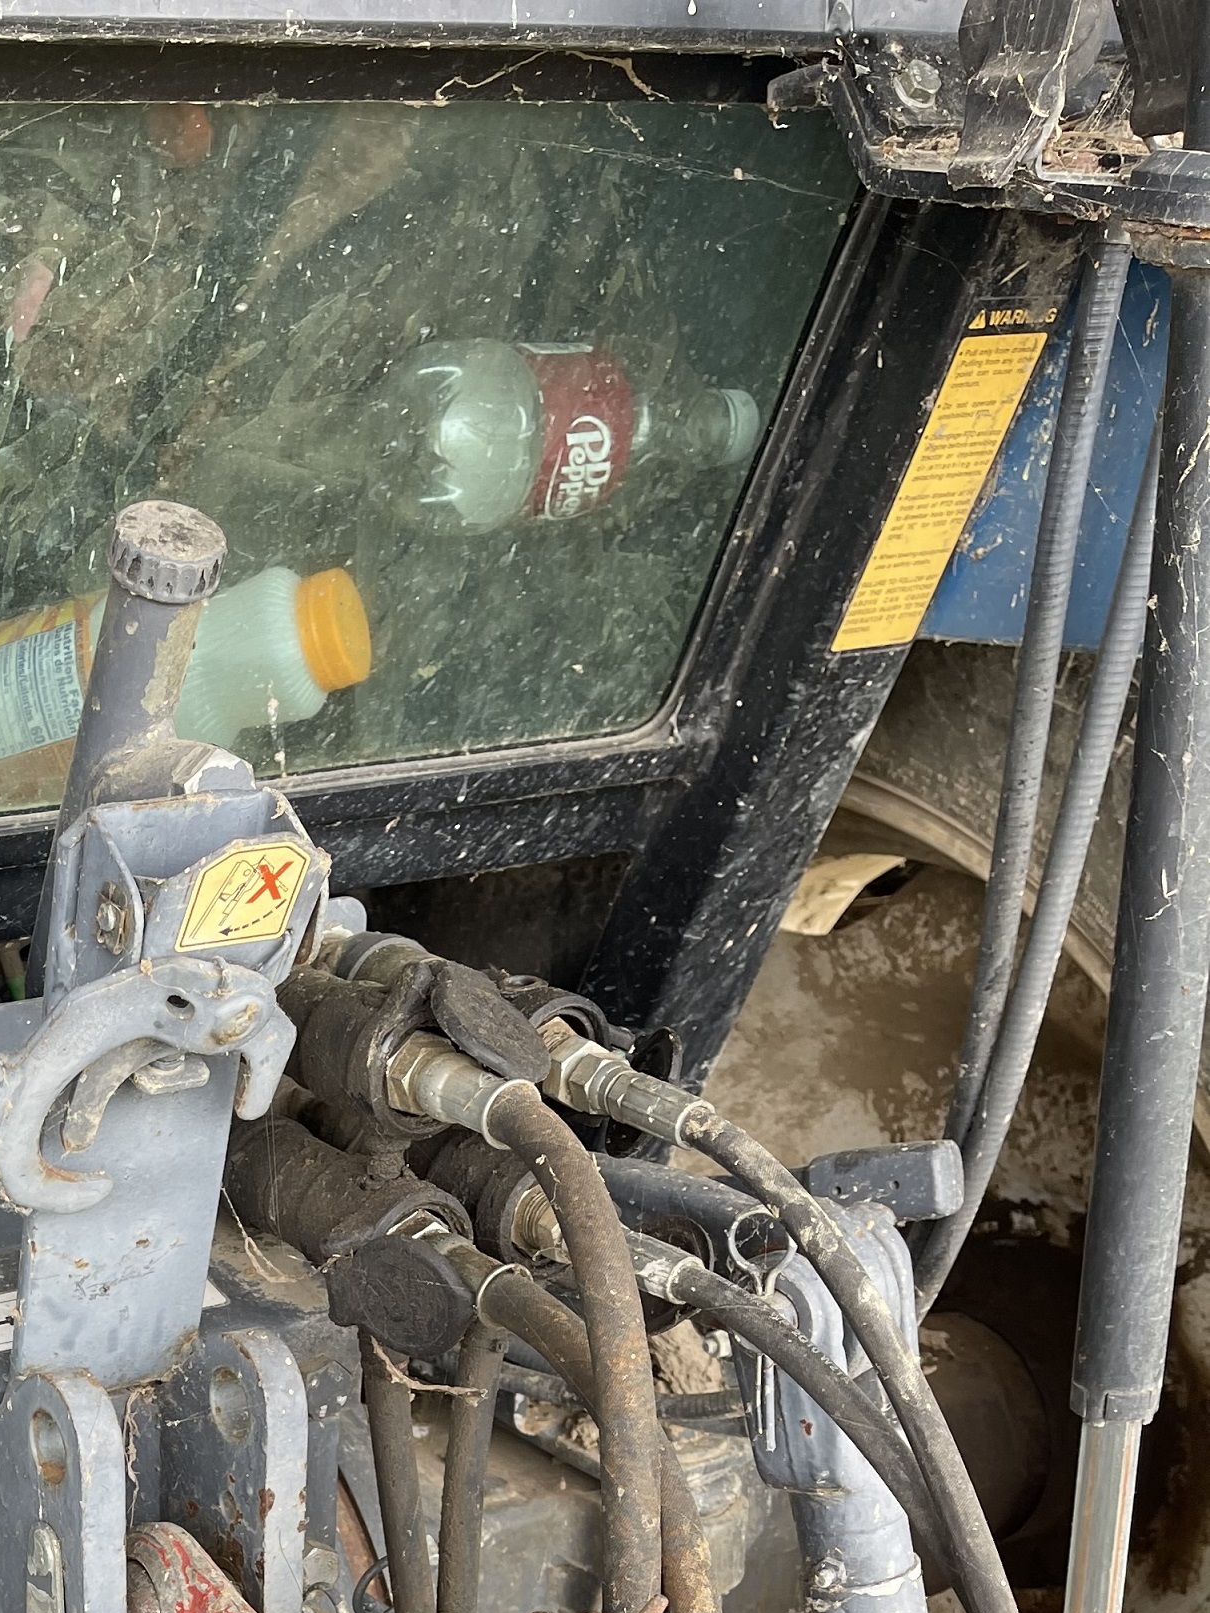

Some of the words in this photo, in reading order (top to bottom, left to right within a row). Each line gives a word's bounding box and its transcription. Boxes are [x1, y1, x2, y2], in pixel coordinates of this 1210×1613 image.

[989, 308, 1058, 325] WARNG
[559, 415, 611, 516] Pepper
[584, 461, 611, 503] Dr
[54, 627, 64, 656] Datos
[63, 622, 74, 685] Nutrition
[54, 659, 63, 674] de
[30, 726, 46, 744] 60
